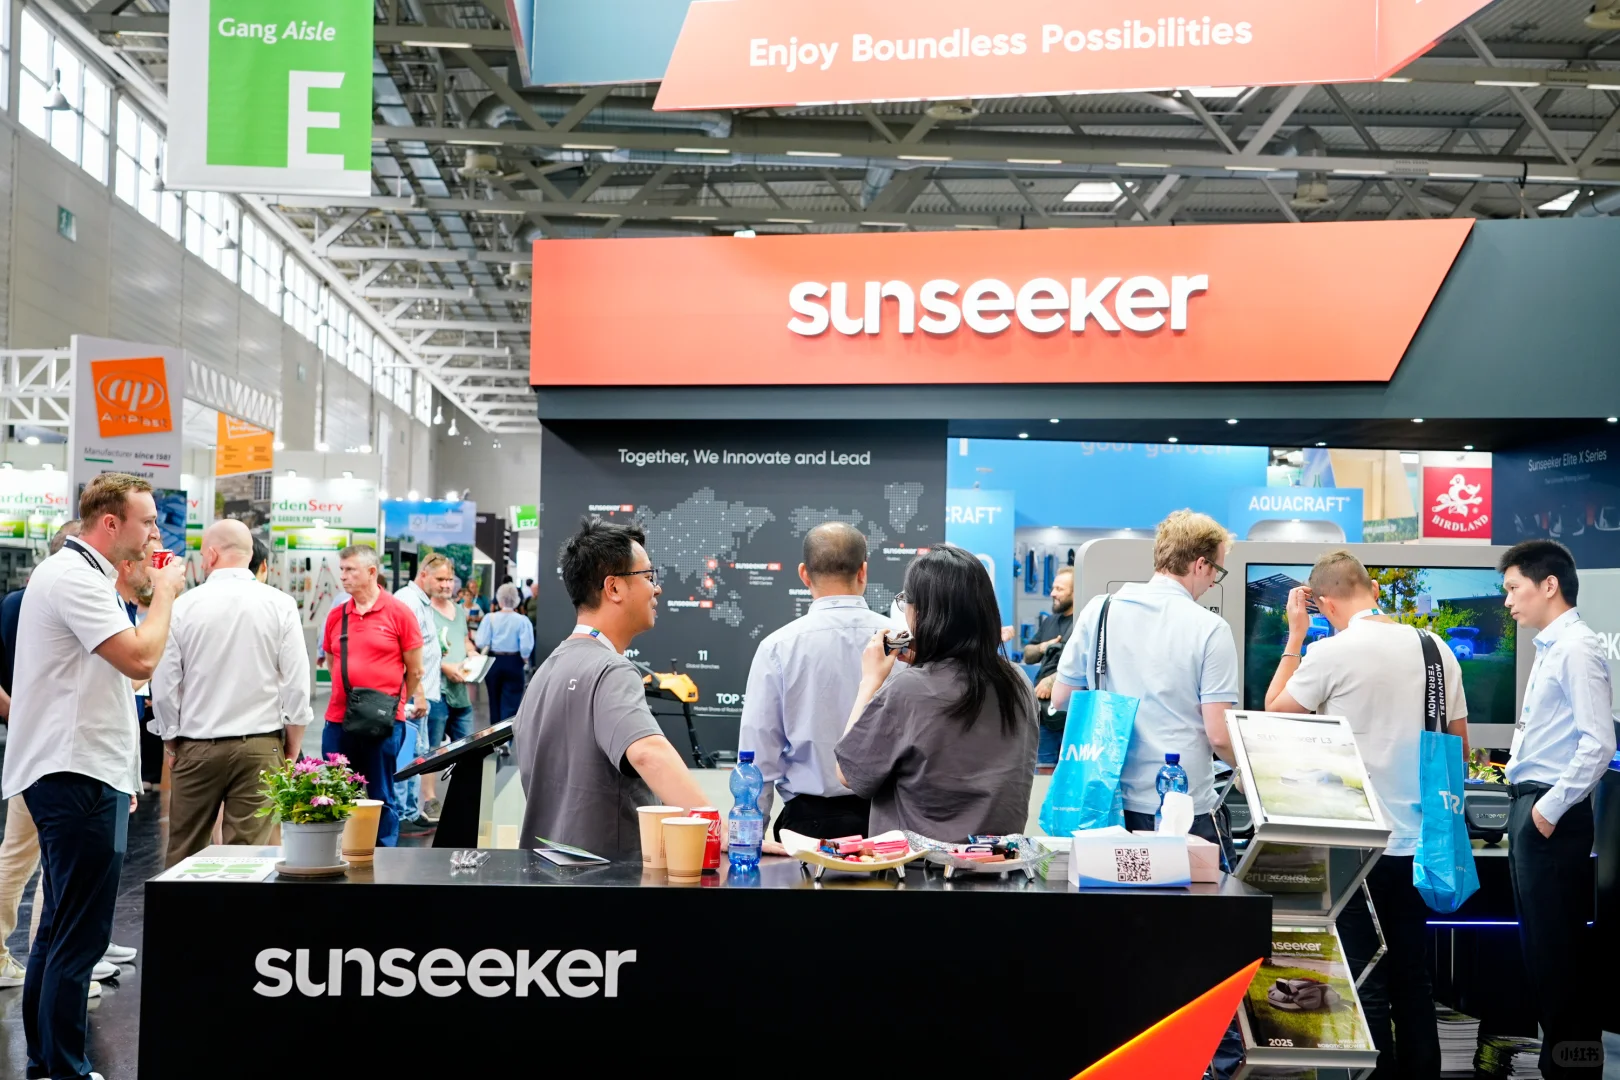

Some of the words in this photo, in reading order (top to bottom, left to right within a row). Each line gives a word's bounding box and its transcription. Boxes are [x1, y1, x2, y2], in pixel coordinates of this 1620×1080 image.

[218, 18, 277, 44] Gang
[282, 21, 336, 41] Aisle
[749, 36, 839, 72] Enjoy
[852, 27, 1027, 62] Boundless
[1041, 16, 1253, 54] Possibilities
[287, 70, 346, 171] E
[786, 274, 1209, 336] sunseeker
[84, 447, 132, 458] Manufacturer
[134, 451, 154, 460] since
[618, 449, 689, 467] Together,
[693, 449, 719, 464] We
[723, 449, 791, 465] Innovate
[795, 450, 826, 465] and
[831, 451, 871, 465] Lead
[1528, 456, 1561, 472] Sunseeker
[1563, 453, 1578, 467] Elite
[1585, 448, 1607, 463] Series
[1431, 515, 1488, 532] BIRDLAND
[698, 650, 708, 661] 11
[716, 693, 740, 705] TOP
[1428, 664, 1436, 718] TERRAMOW
[1435, 663, 1445, 716] TERRAMOW
[253, 947, 637, 998] sunseeker
[1268, 1038, 1294, 1047] 2025
